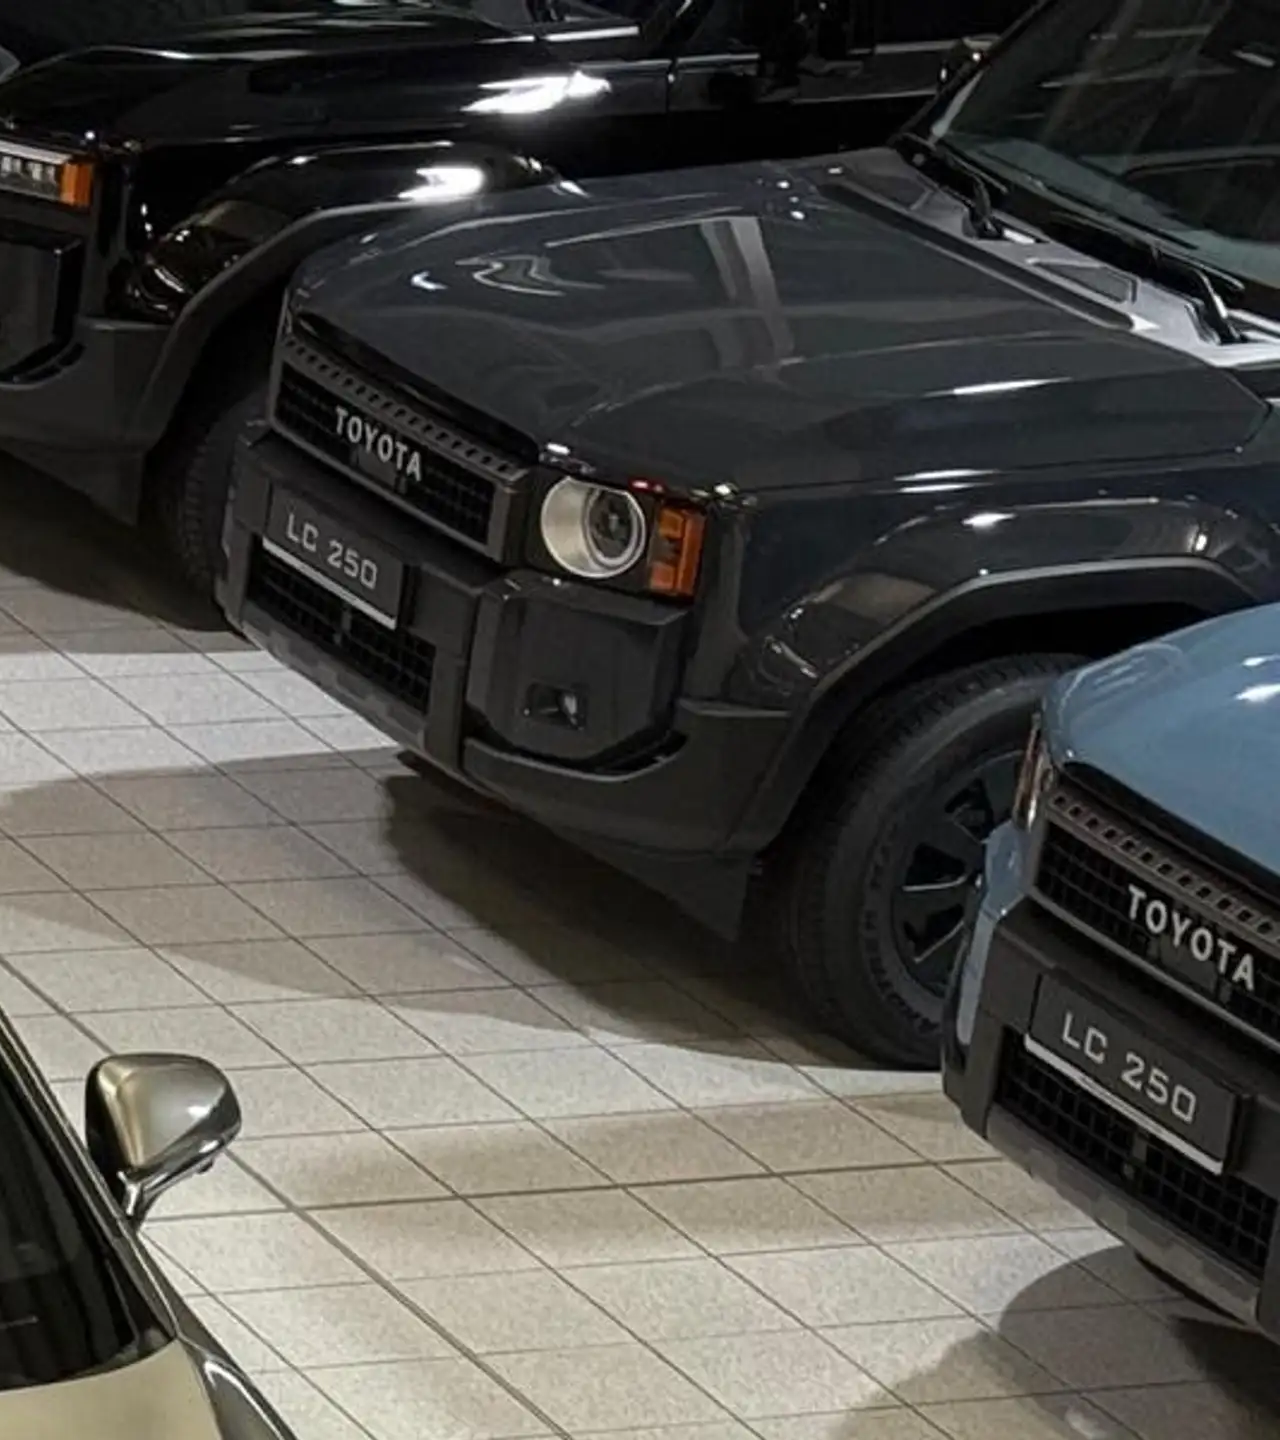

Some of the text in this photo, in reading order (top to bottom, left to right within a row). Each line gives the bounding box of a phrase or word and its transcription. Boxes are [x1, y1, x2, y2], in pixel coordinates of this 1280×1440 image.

[335, 405, 422, 482] TOYOTA
[286, 512, 378, 590] LC 250
[1128, 884, 1255, 991] TOYOTA
[1061, 1011, 1197, 1124] LC 250
